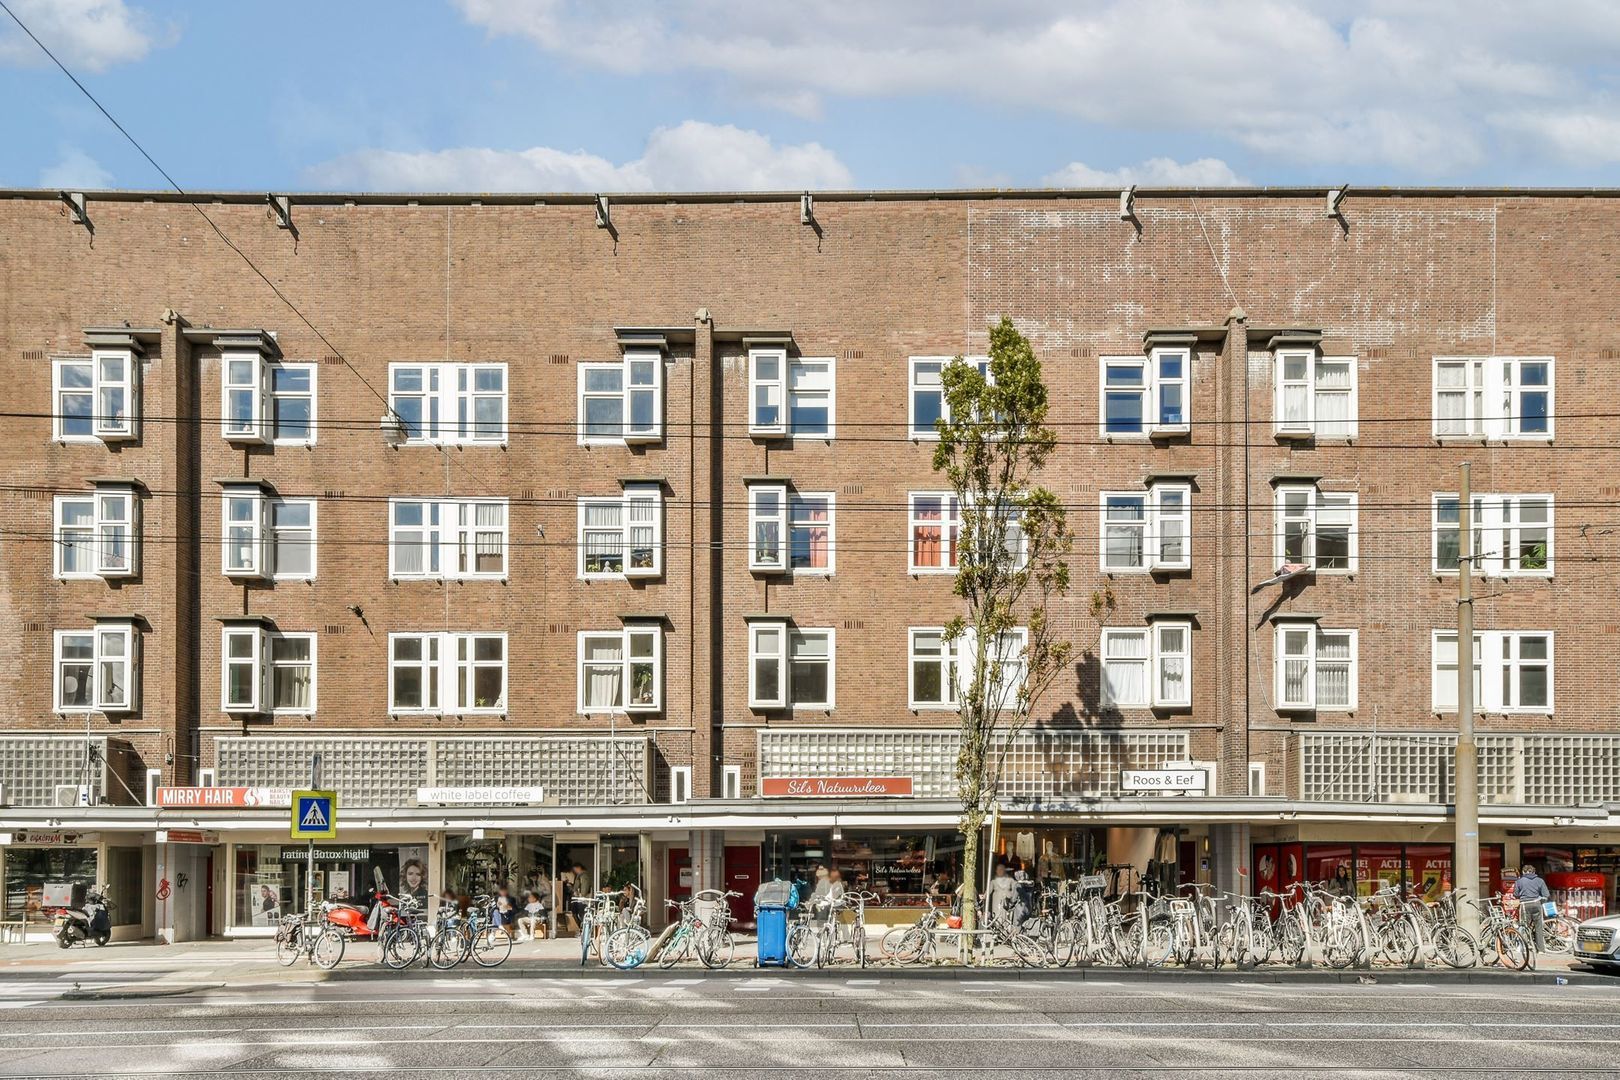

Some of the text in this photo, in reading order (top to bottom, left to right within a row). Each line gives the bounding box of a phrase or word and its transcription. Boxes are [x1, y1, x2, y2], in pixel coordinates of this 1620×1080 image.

[1133, 775, 1195, 785] Roos & Eef
[787, 780, 887, 794] Sil's Natuurvlees
[162, 789, 234, 805] MIRRY HAIR
[430, 789, 531, 800] white label coffee
[313, 849, 341, 859] Botox
[1338, 859, 1368, 868] ACIE!
[1380, 859, 1411, 869] ACTI!
